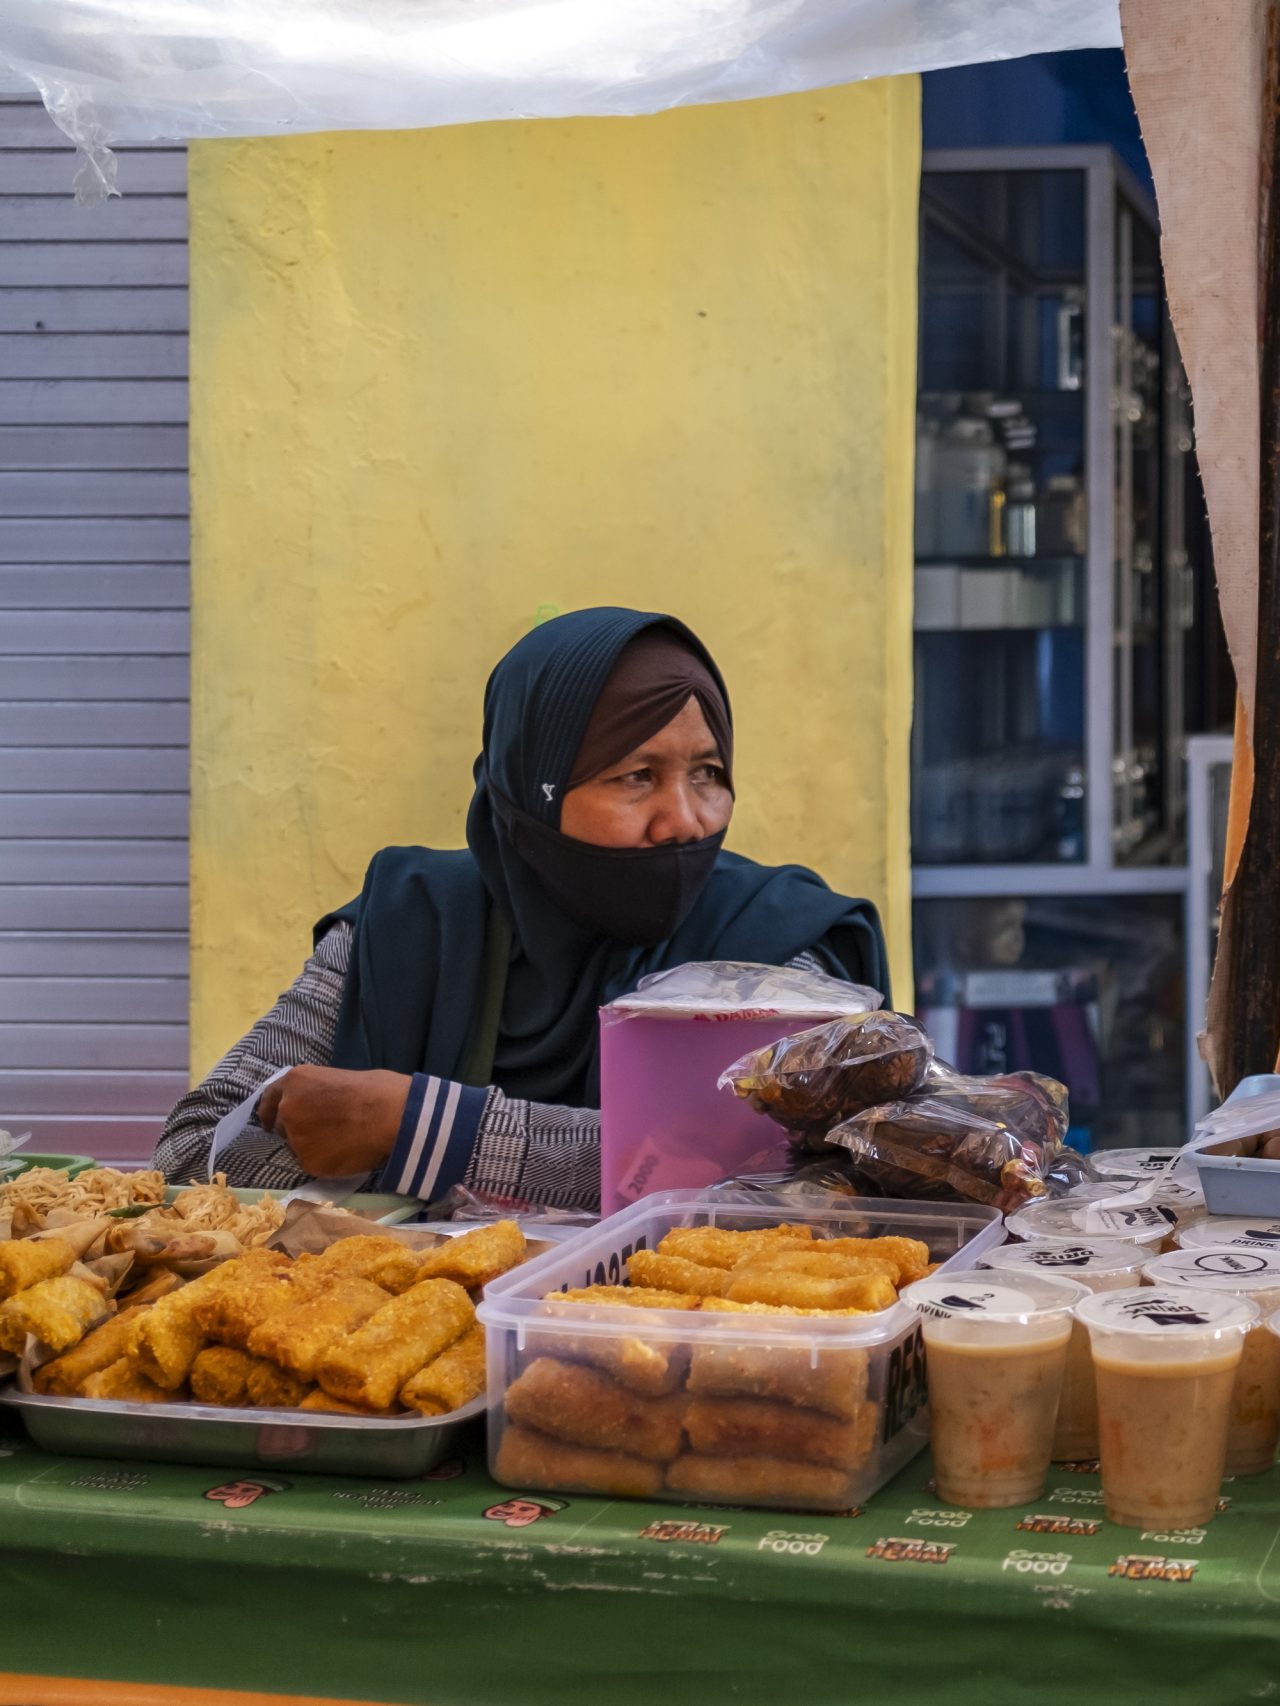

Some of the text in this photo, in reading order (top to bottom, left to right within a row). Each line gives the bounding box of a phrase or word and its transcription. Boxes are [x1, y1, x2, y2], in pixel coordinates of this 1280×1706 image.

[1230, 1239, 1277, 1248] DRINK
[1028, 1250, 1095, 1260] DRINK
[1130, 1305, 1196, 1315] DRINK
[912, 1508, 973, 1519] Grab
[904, 1516, 969, 1527] Food
[767, 1530, 830, 1542] Grab
[1140, 1534, 1204, 1544] Food
[758, 1537, 825, 1555] Food
[1008, 1549, 1072, 1561] Grab
[1002, 1557, 1069, 1575] Food
